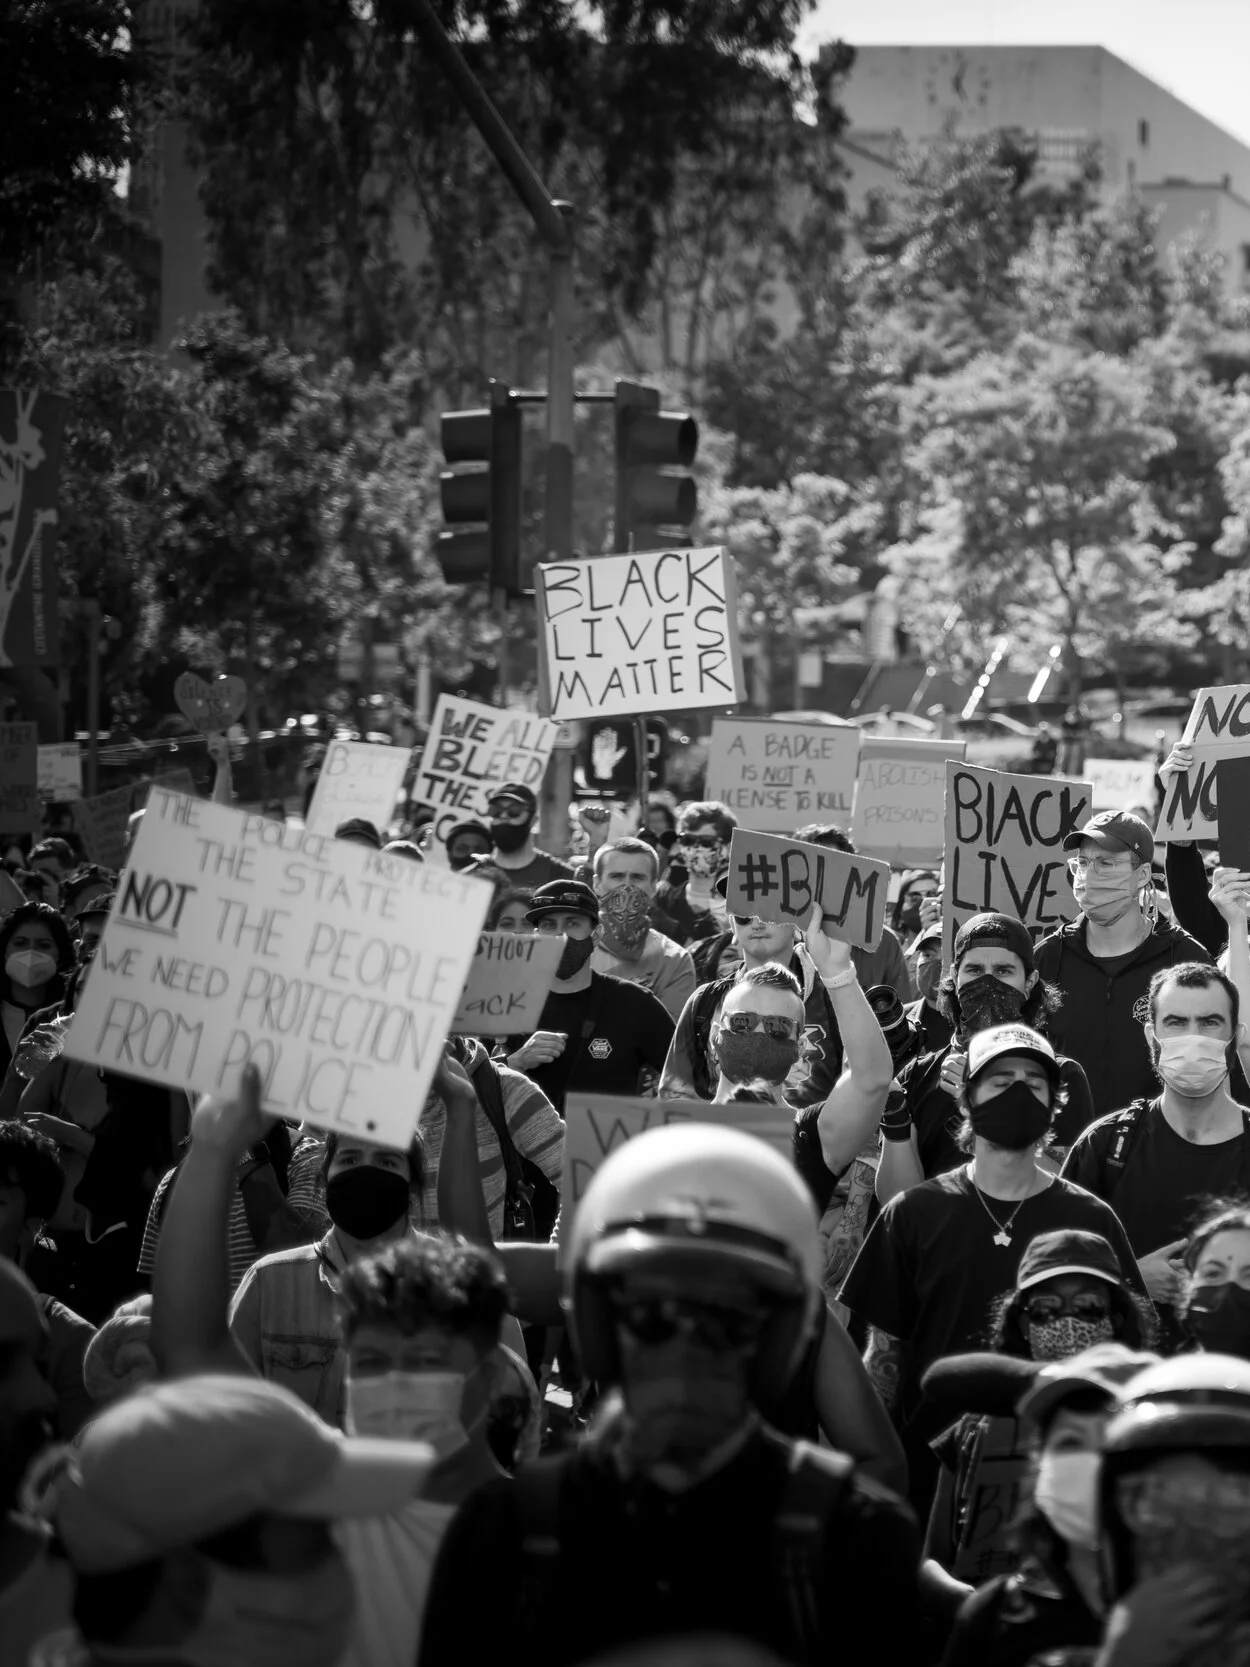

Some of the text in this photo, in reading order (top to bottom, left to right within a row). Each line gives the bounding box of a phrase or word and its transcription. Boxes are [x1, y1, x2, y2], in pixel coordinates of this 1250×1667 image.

[544, 553, 726, 622] BLACK
[553, 606, 725, 660] LIVES
[551, 650, 732, 715] MATTER
[440, 708, 550, 754] WE ALL
[727, 734, 836, 759] A BADGE
[432, 739, 543, 784] BLEED
[741, 765, 816, 785] IS NOT A
[706, 786, 789, 811] LICENSE
[816, 791, 852, 812] KILL
[863, 804, 939, 828] PRISONS
[154, 790, 201, 829] THE
[239, 814, 337, 863] POLICE
[363, 850, 480, 906] PROTECT
[196, 838, 402, 920] THE STATE
[738, 849, 880, 943] #BLM
[119, 870, 459, 1010] NOT THE PEOPLE
[474, 936, 543, 963] SHOOT
[99, 940, 436, 1073] WE NEED PROTECTION
[96, 998, 379, 1133] FROM POLICE.
